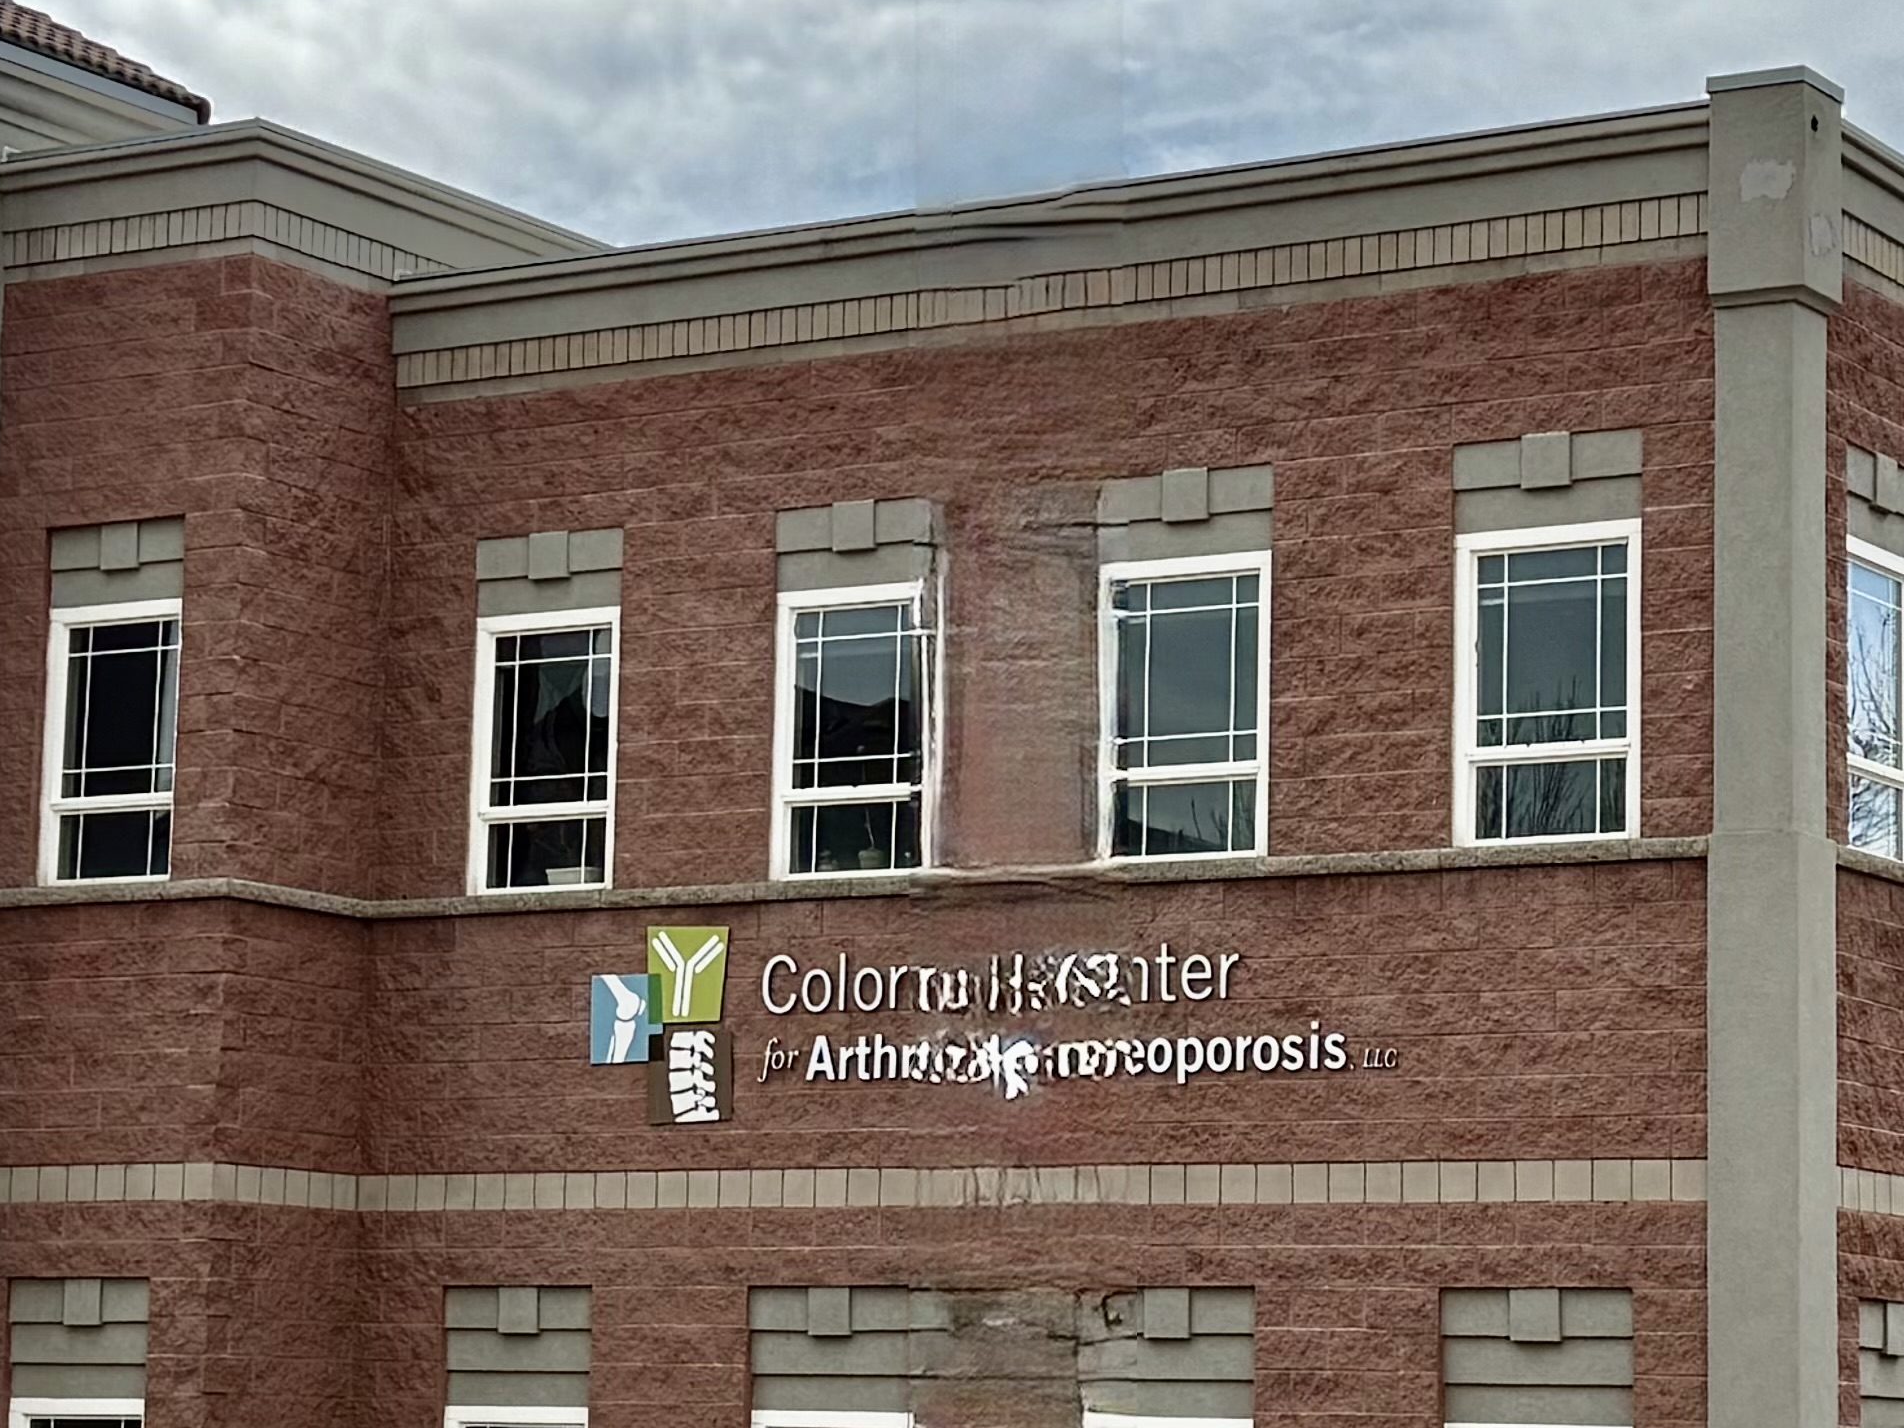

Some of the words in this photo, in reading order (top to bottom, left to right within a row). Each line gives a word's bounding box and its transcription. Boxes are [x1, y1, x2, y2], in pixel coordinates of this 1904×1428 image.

[761, 951, 996, 1015] Color
[1053, 942, 1239, 1009] nter
[757, 1036, 799, 1083] for
[805, 1033, 983, 1082] Arthr
[1363, 1047, 1398, 1068] LLC
